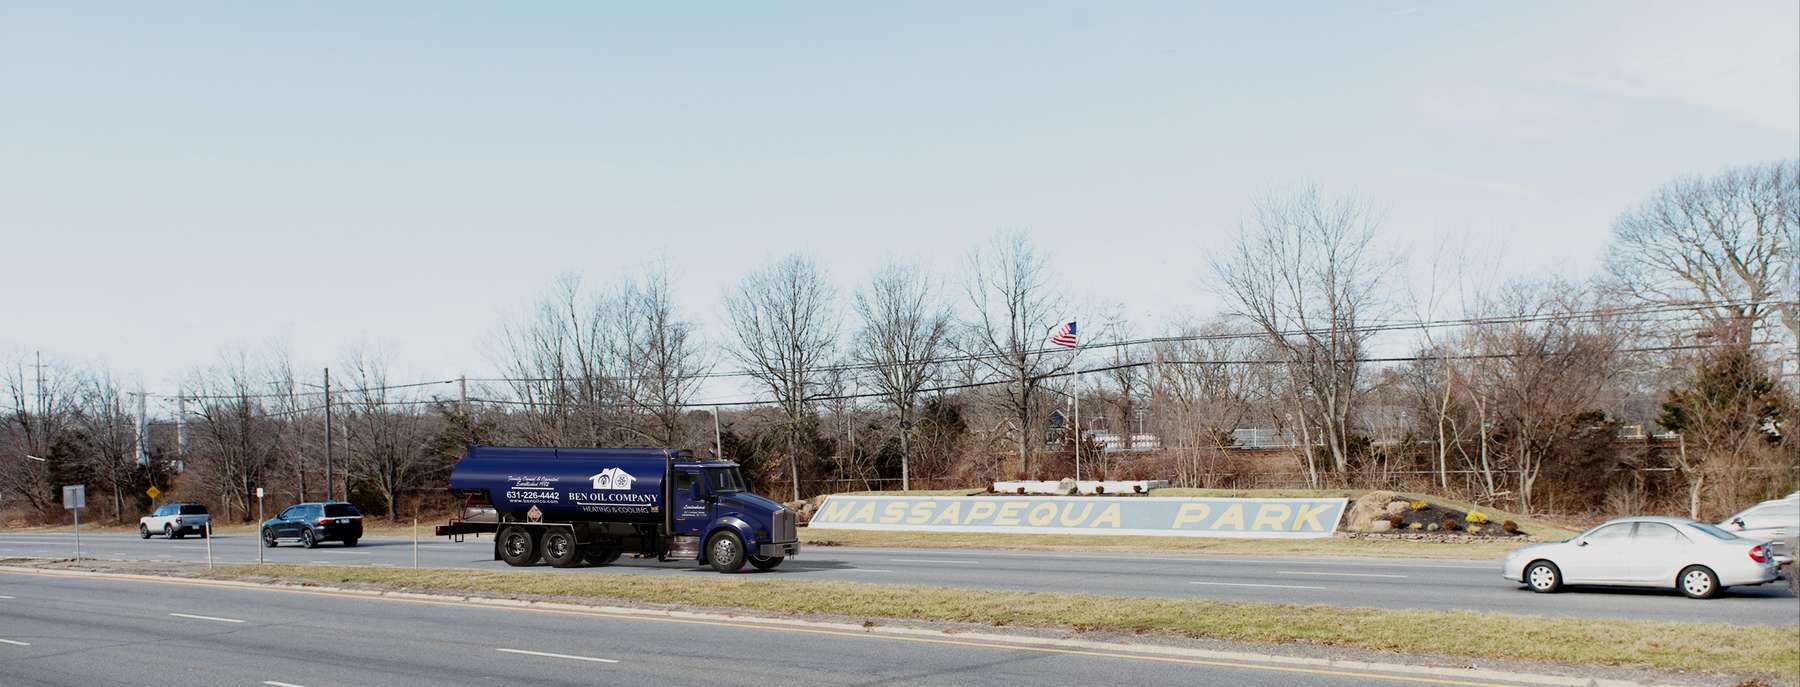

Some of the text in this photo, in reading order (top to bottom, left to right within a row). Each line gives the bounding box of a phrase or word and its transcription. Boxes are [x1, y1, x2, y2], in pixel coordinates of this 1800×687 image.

[506, 491, 560, 500] 631-226-4442
[569, 492, 658, 502] BEN OIL COMPANY
[582, 505, 612, 513] HEATING
[618, 506, 649, 514] COOLING
[821, 501, 1334, 531] MASSAPEQUA PARK
